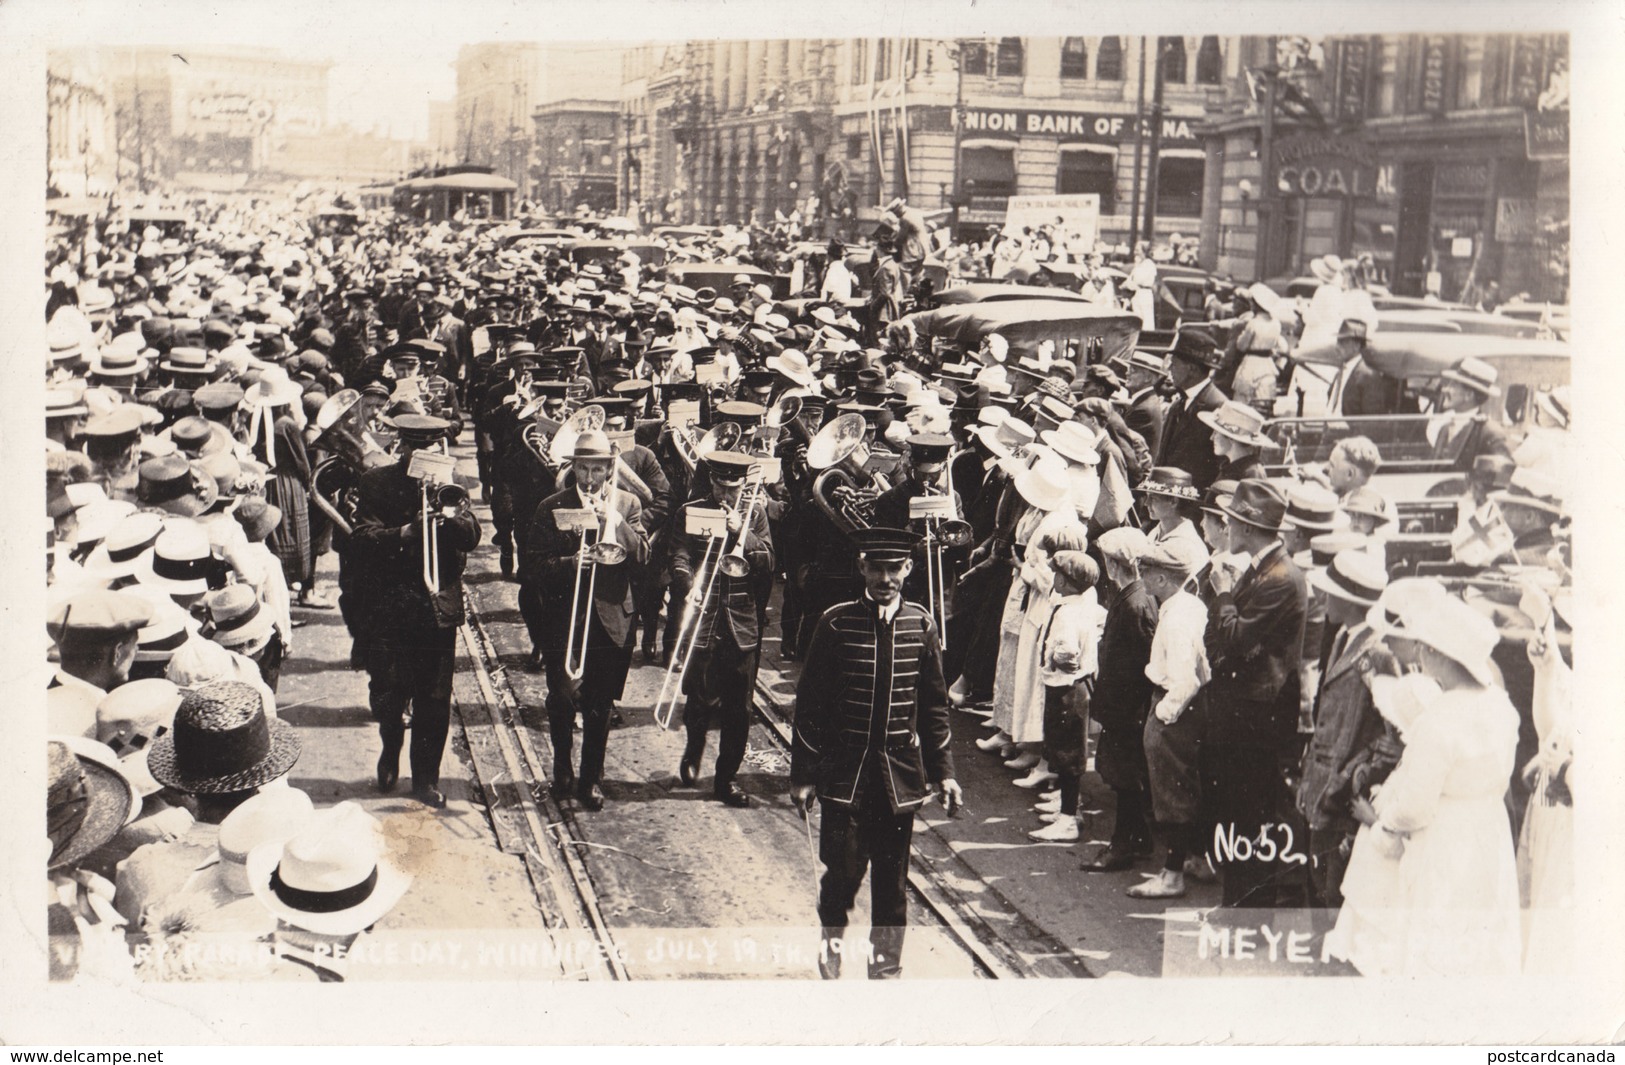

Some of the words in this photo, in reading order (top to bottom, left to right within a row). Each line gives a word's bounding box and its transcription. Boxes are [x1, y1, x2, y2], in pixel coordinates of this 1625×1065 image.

[1027, 114, 1084, 135] BANK
[1094, 117, 1124, 136] OF
[1277, 165, 1370, 194] COAL
